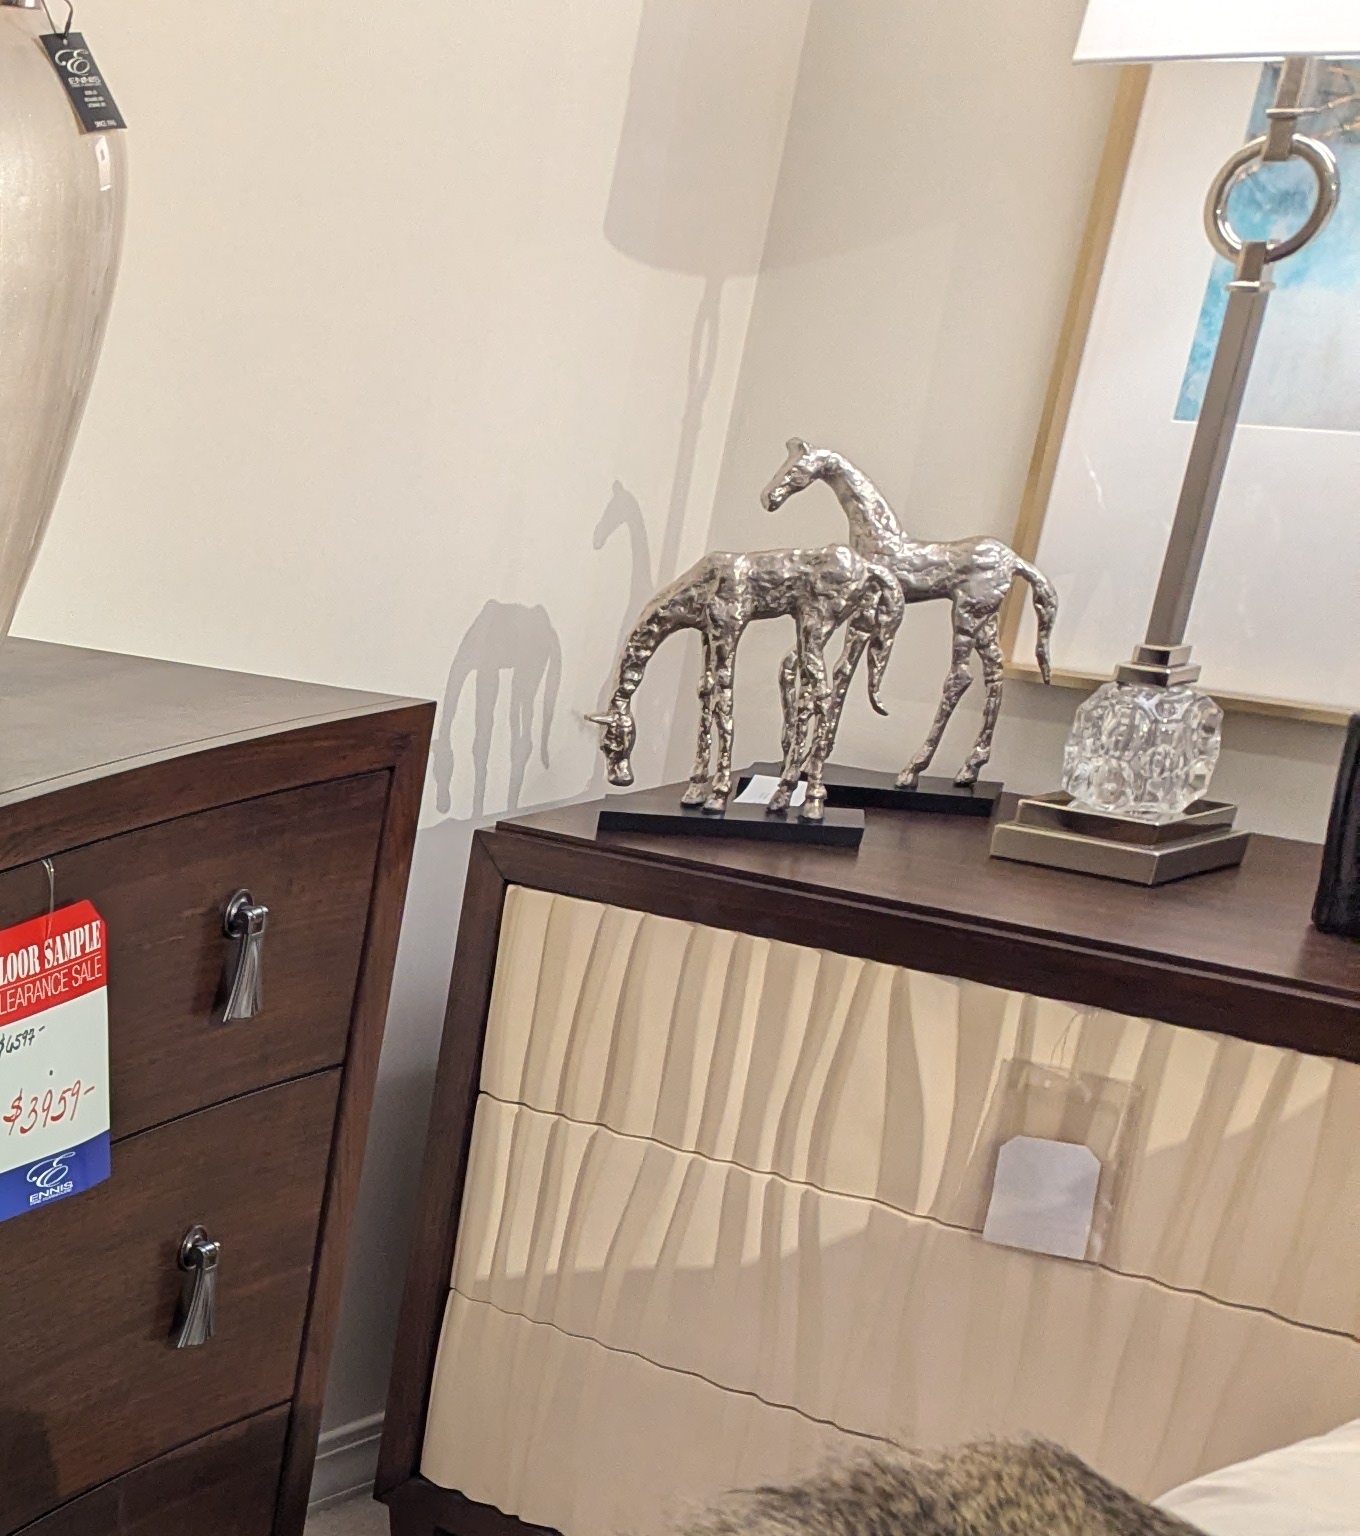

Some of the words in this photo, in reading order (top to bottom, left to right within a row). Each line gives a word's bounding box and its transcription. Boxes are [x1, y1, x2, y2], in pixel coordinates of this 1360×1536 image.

[44, 920, 101, 969] SAMPLE
[72, 956, 102, 987] SALE
[29, 1181, 73, 1203] ENNIS
